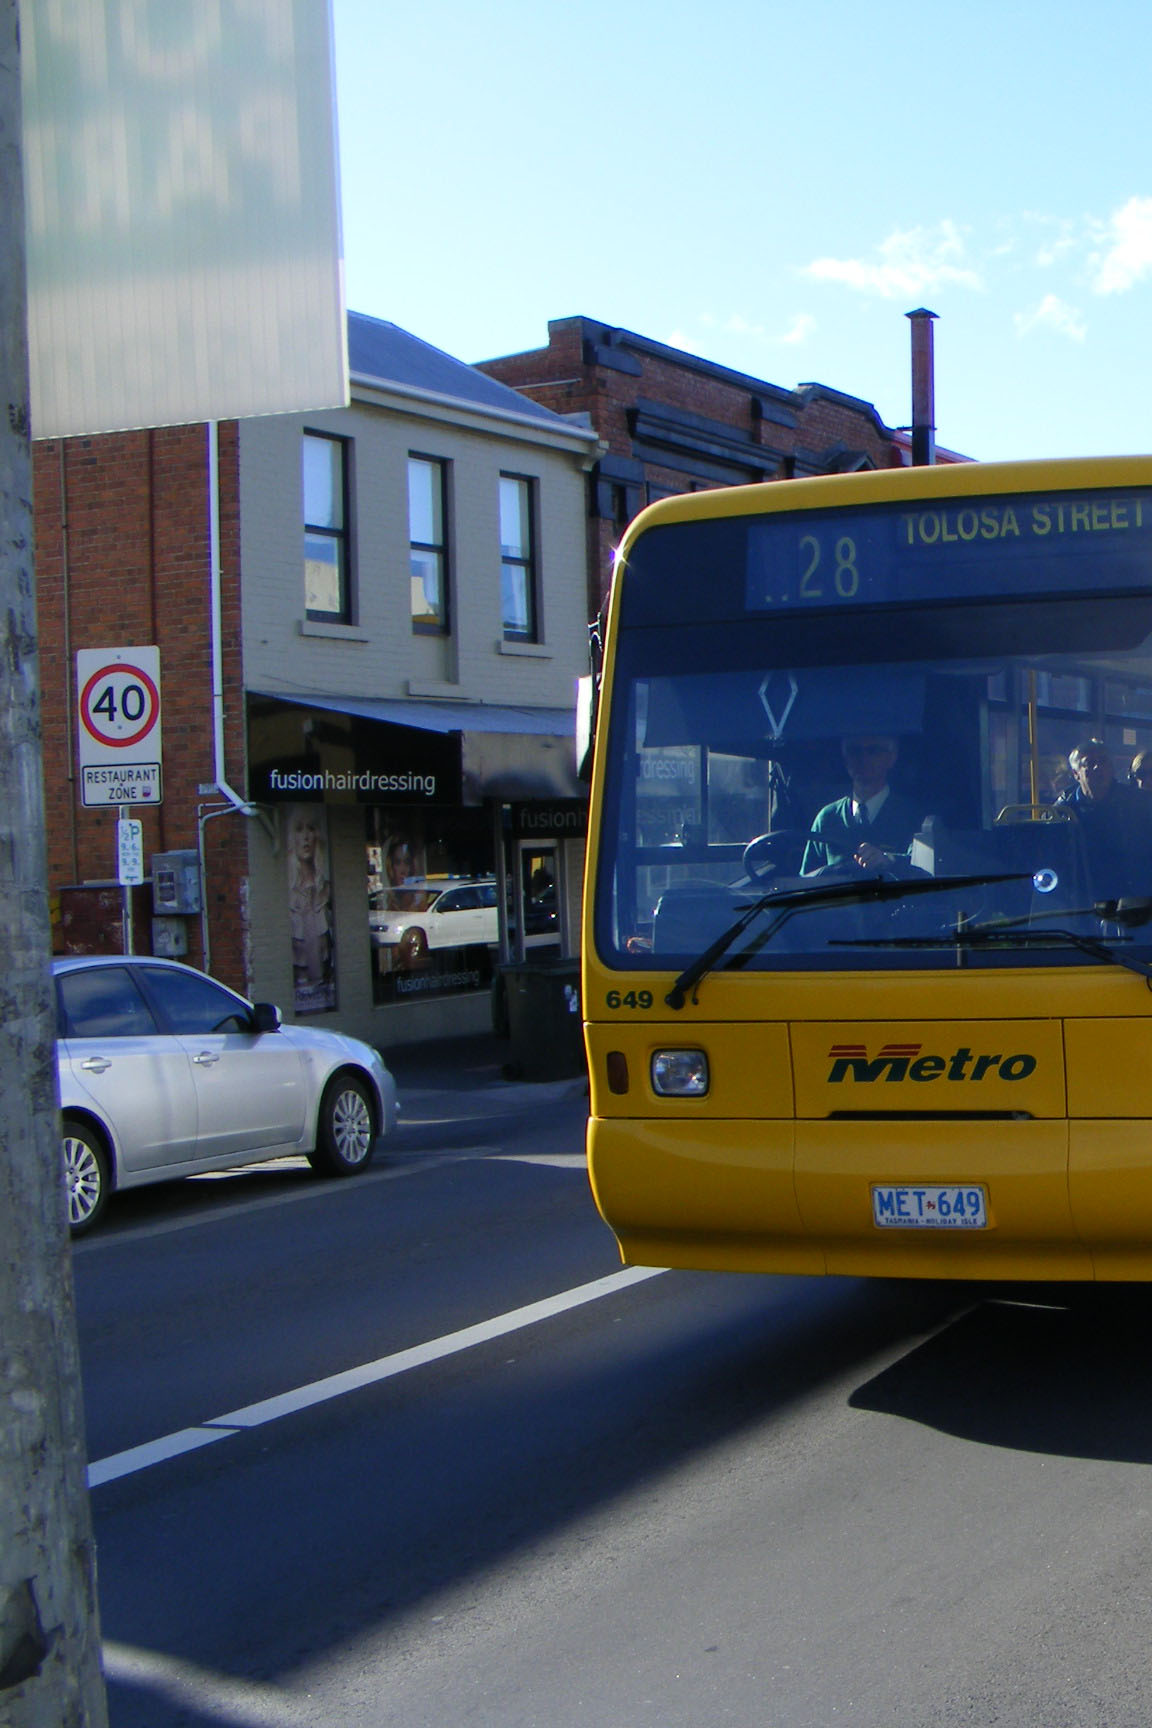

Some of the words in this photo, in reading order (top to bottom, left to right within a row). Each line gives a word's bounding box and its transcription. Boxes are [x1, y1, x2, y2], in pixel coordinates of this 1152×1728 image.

[902, 505, 1021, 545] TOLOSA
[1031, 498, 1143, 536] STREET
[799, 534, 860, 598] 28
[92, 684, 146, 722] 40
[86, 768, 157, 784] RESTAURANT
[270, 769, 436, 796] fusionhairdressing
[108, 786, 137, 800] ZONE
[606, 990, 654, 1009] 649
[827, 1043, 1037, 1083] Metro
[877, 1191, 926, 1216] MET
[937, 1191, 981, 1217] 649
[885, 1217, 919, 1225] TASMANIA
[961, 1217, 978, 1225] ISLE
